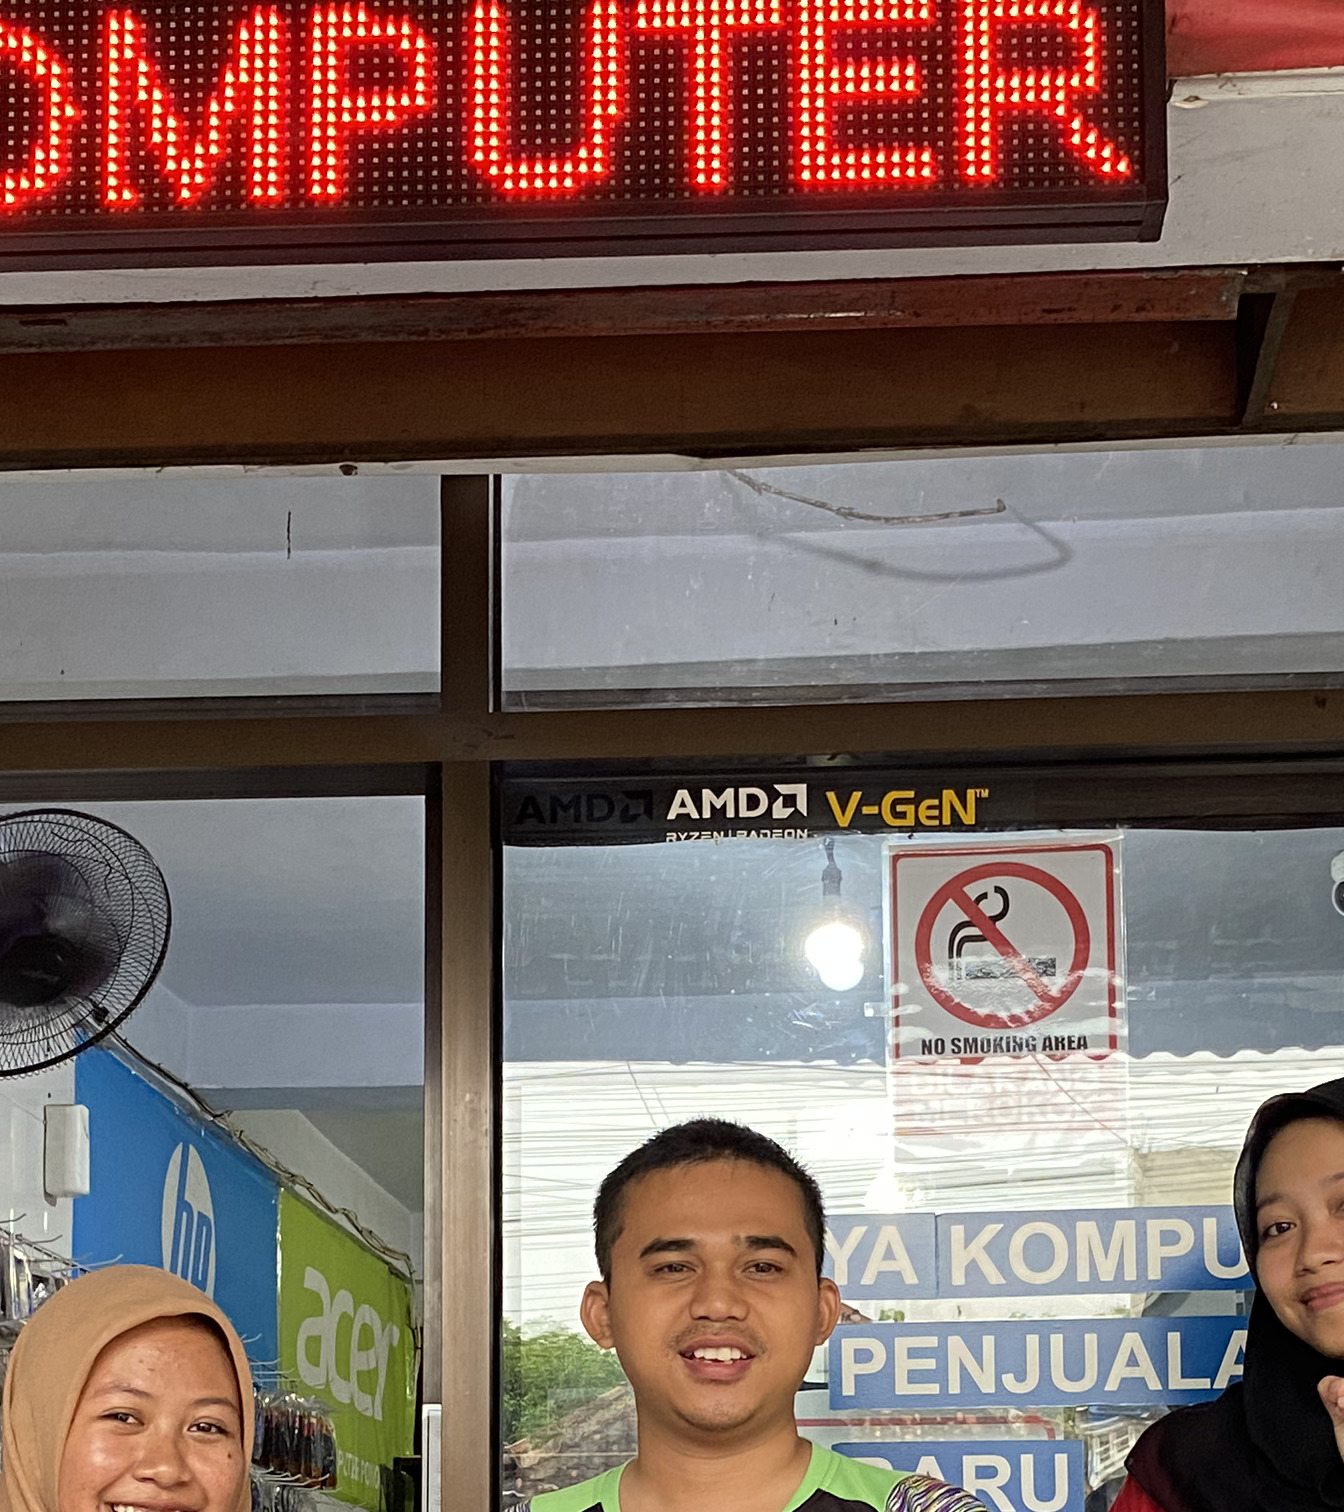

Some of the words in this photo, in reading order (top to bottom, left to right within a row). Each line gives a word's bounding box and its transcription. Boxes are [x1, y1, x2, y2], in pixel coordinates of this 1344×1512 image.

[667, 787, 769, 820] AMD
[921, 1037, 945, 1056] NO
[950, 1035, 1037, 1056] SMOKING
[1042, 1035, 1089, 1054] AREA
[824, 1225, 919, 1286] YA
[297, 1266, 400, 1421] acer
[840, 1330, 1246, 1397] PENJUALA
